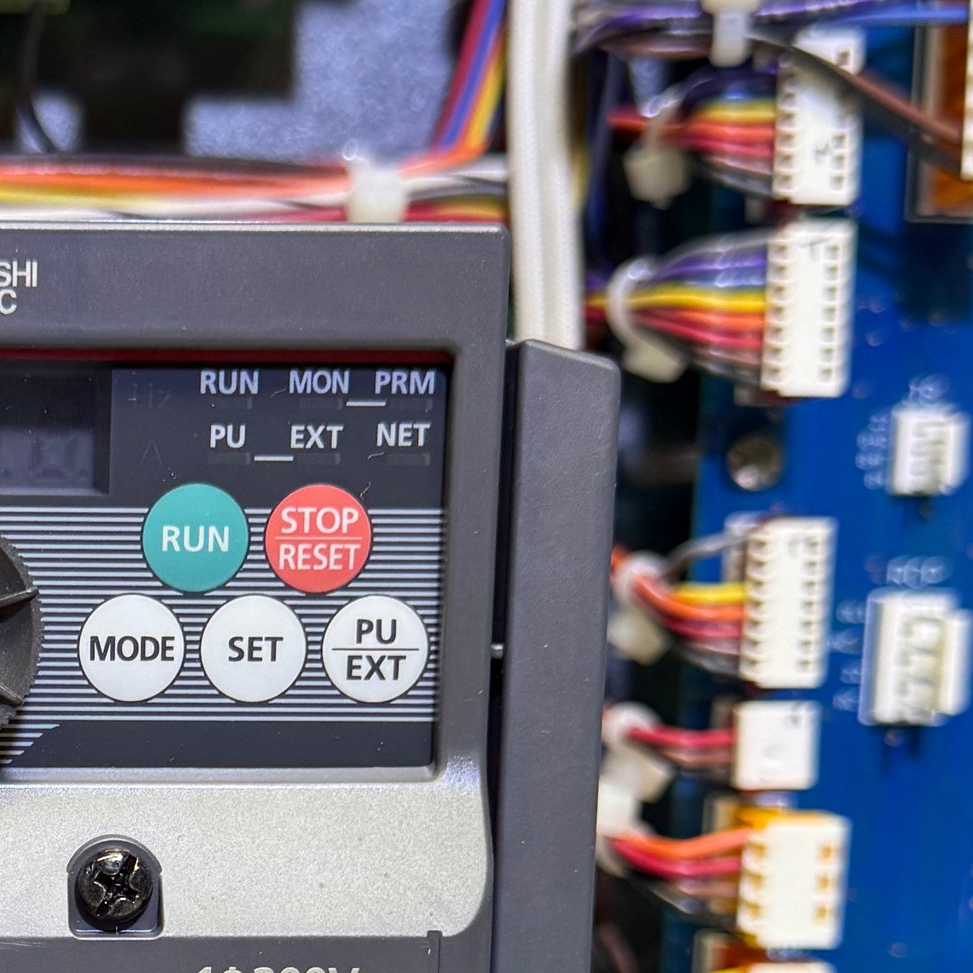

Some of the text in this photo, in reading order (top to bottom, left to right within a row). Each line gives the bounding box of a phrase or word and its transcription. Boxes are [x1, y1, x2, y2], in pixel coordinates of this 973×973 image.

[200, 370, 436, 395] RUN MON PRM
[209, 422, 431, 449] PU EXT NET
[281, 506, 359, 534] STOP
[162, 525, 230, 553] RUN
[278, 543, 361, 571] RESET
[356, 618, 397, 645] PU
[89, 635, 175, 662] MODE
[228, 636, 284, 662] SET
[346, 655, 407, 681] EXT
